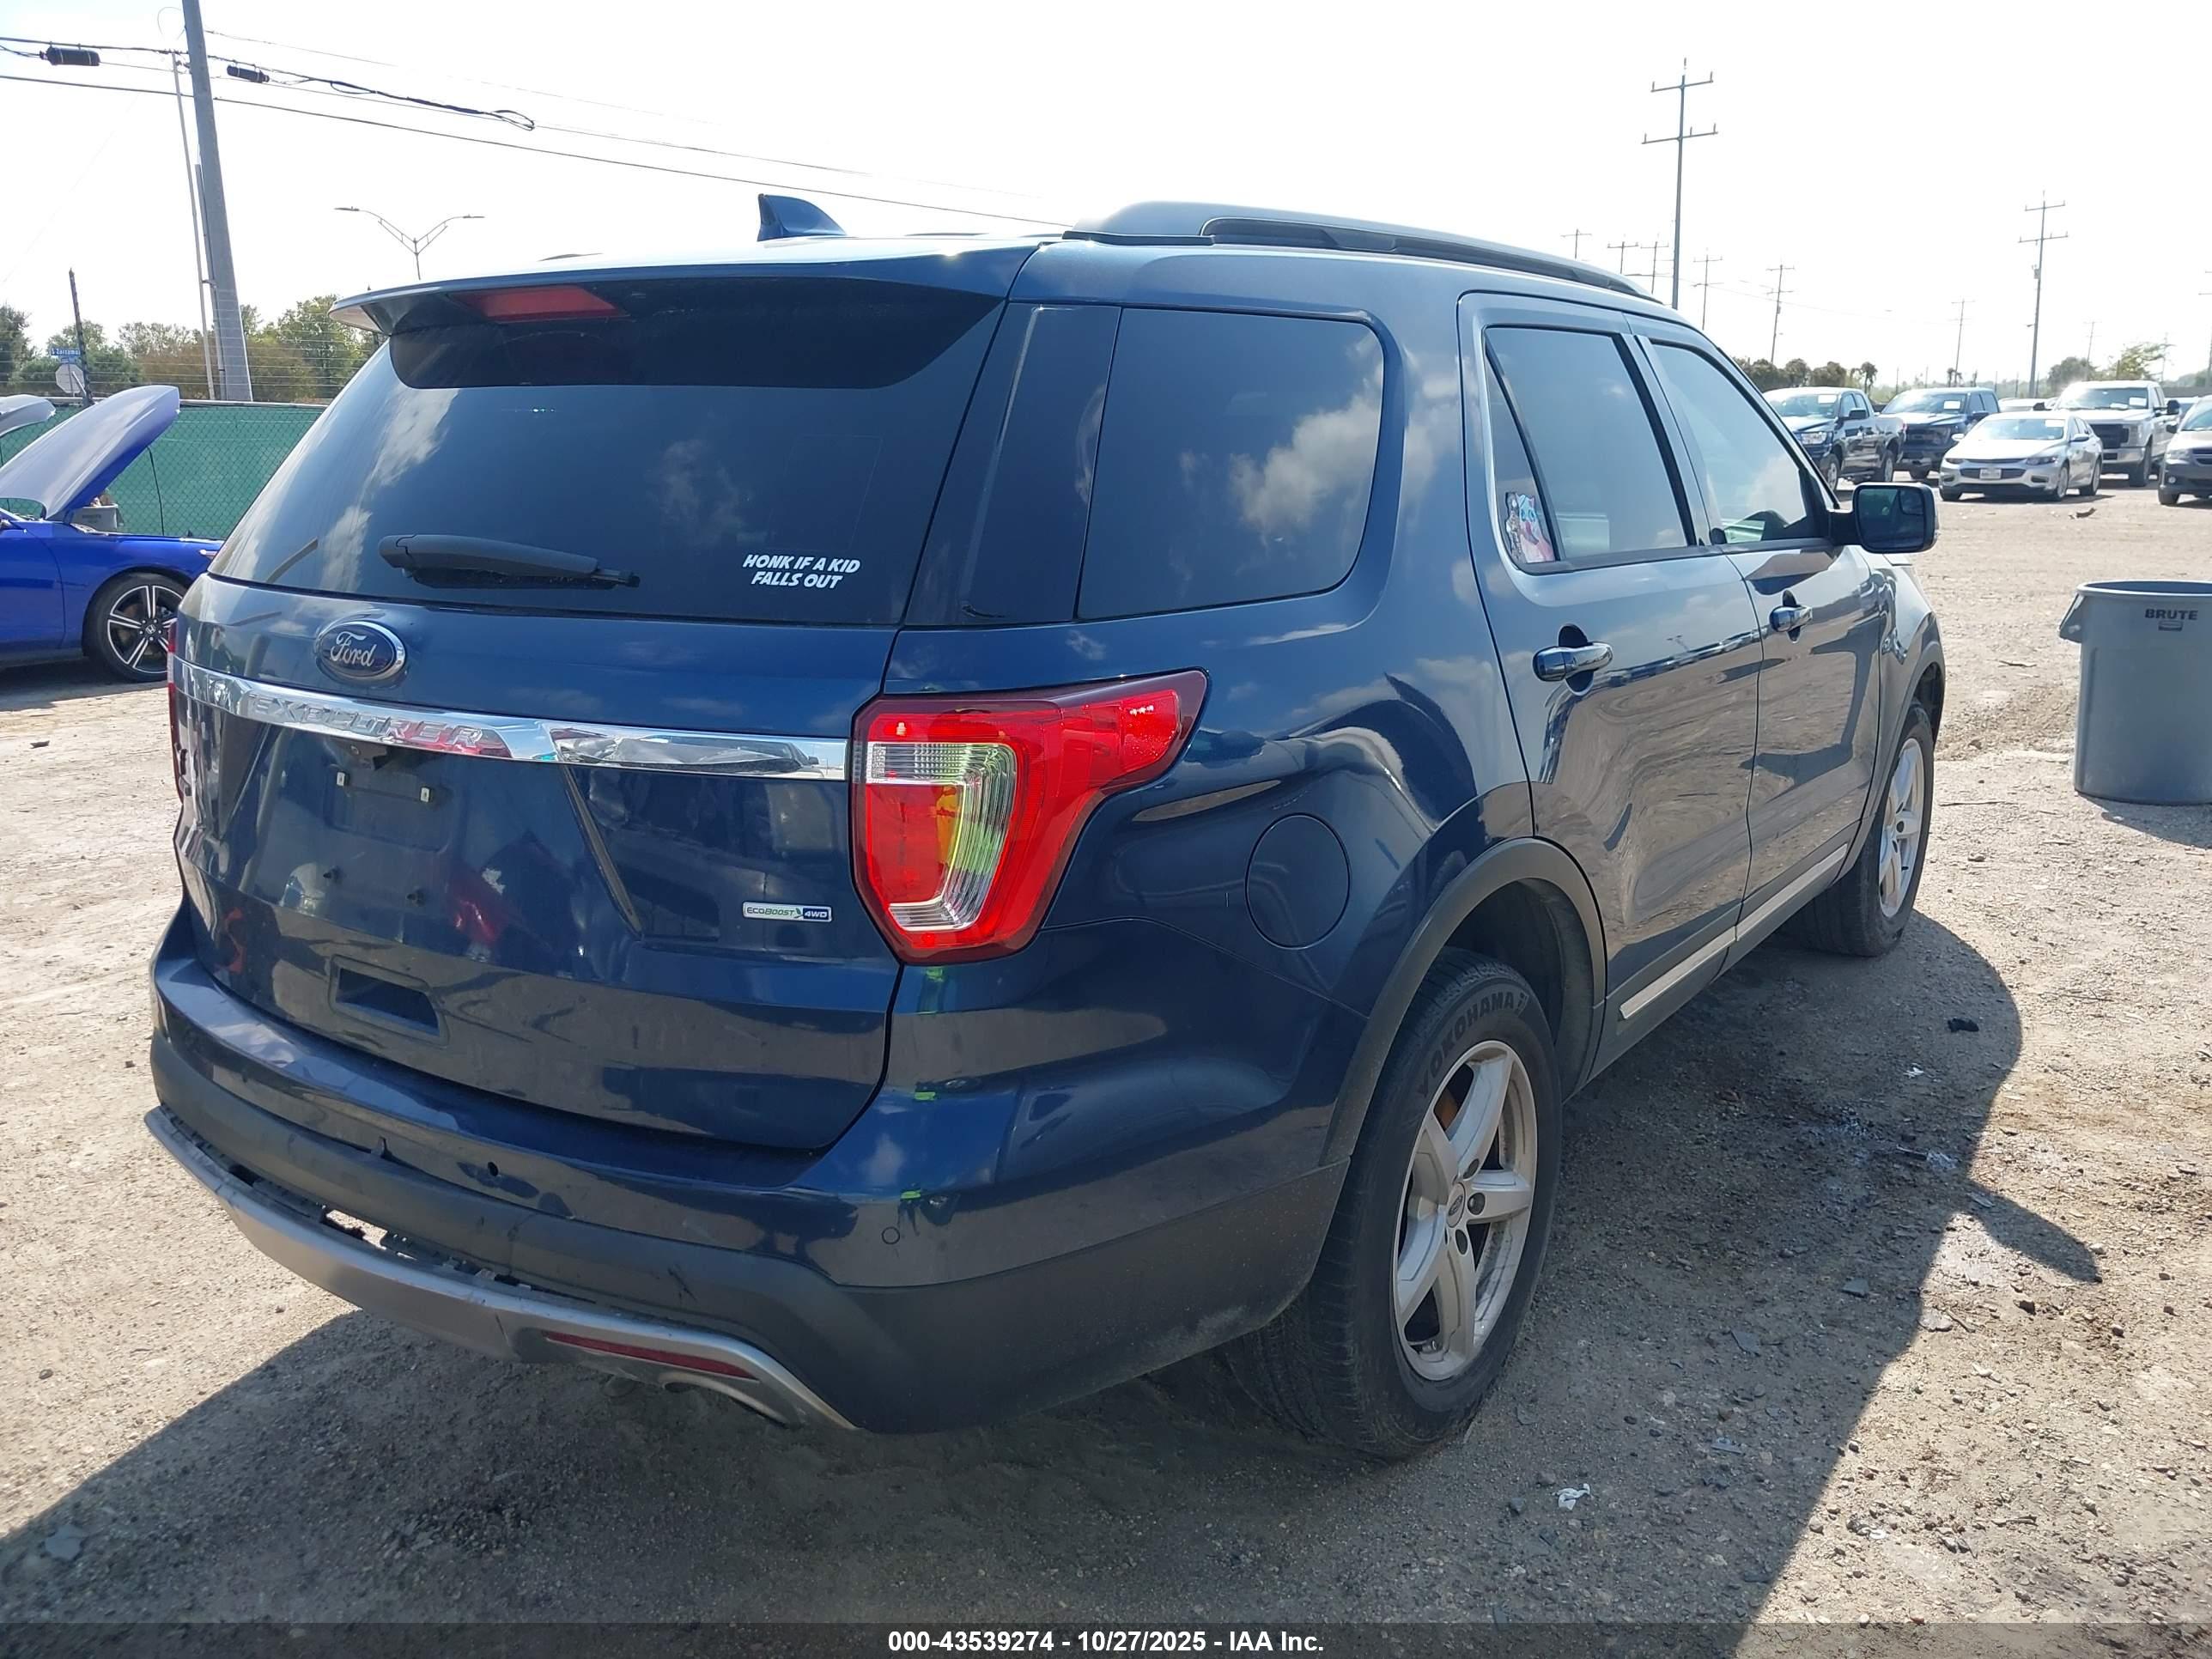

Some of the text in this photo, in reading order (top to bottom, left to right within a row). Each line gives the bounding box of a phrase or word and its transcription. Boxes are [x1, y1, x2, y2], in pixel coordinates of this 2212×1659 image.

[742, 554, 860, 573] HONK IF A KID
[750, 571, 843, 588] FALLS OUT
[2145, 609, 2198, 620] BRUTE
[330, 631, 377, 666] Ford
[248, 692, 483, 748] EXPLORER
[1417, 992, 1515, 1097] YOKOHAMA
